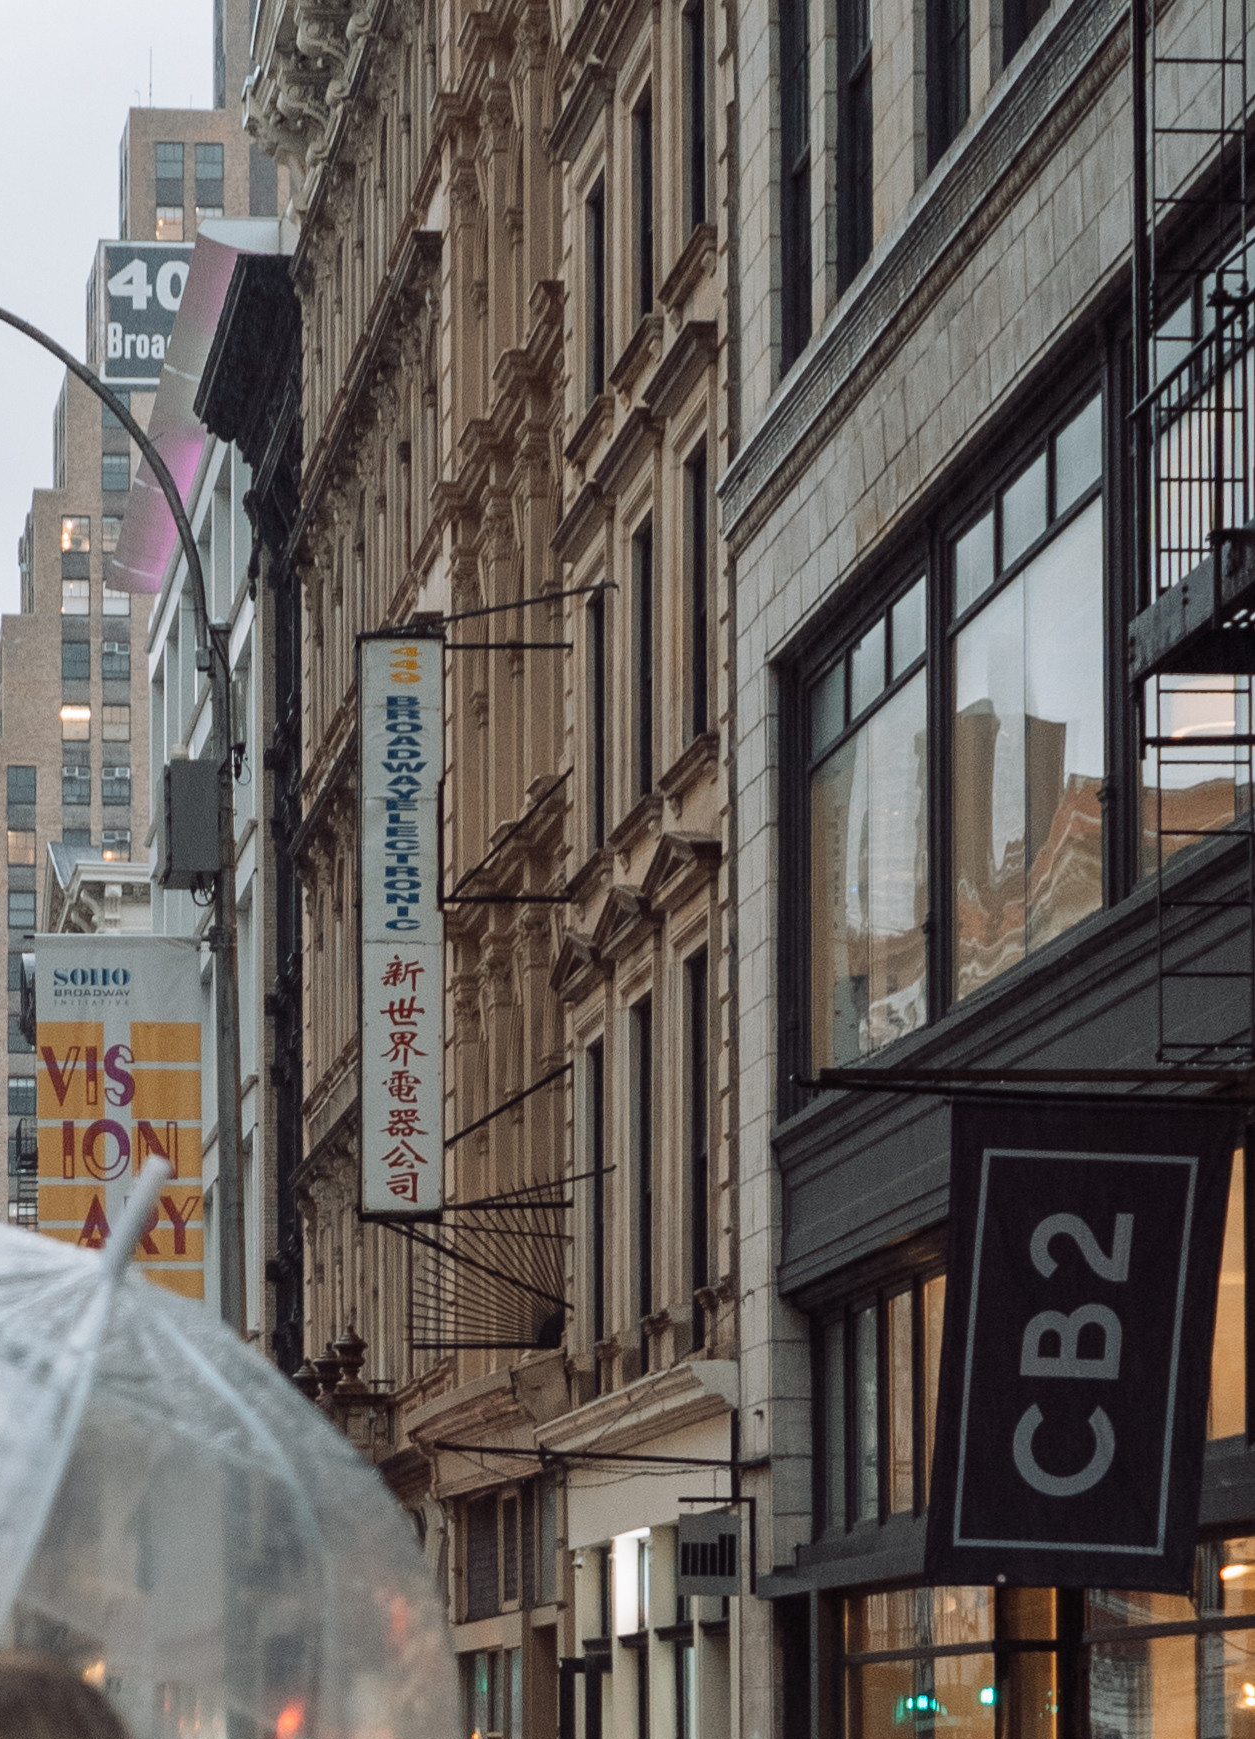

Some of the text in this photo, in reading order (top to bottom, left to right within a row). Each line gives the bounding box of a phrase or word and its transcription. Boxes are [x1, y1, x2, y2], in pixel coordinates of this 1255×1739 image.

[53, 967, 131, 987] SOHO
[54, 989, 130, 997] BROADWAY
[41, 1044, 135, 1107] VIS
[380, 953, 428, 1203] 新世界電器公司
[62, 1119, 178, 1181] ION
[1013, 1213, 1134, 1496] CB2
